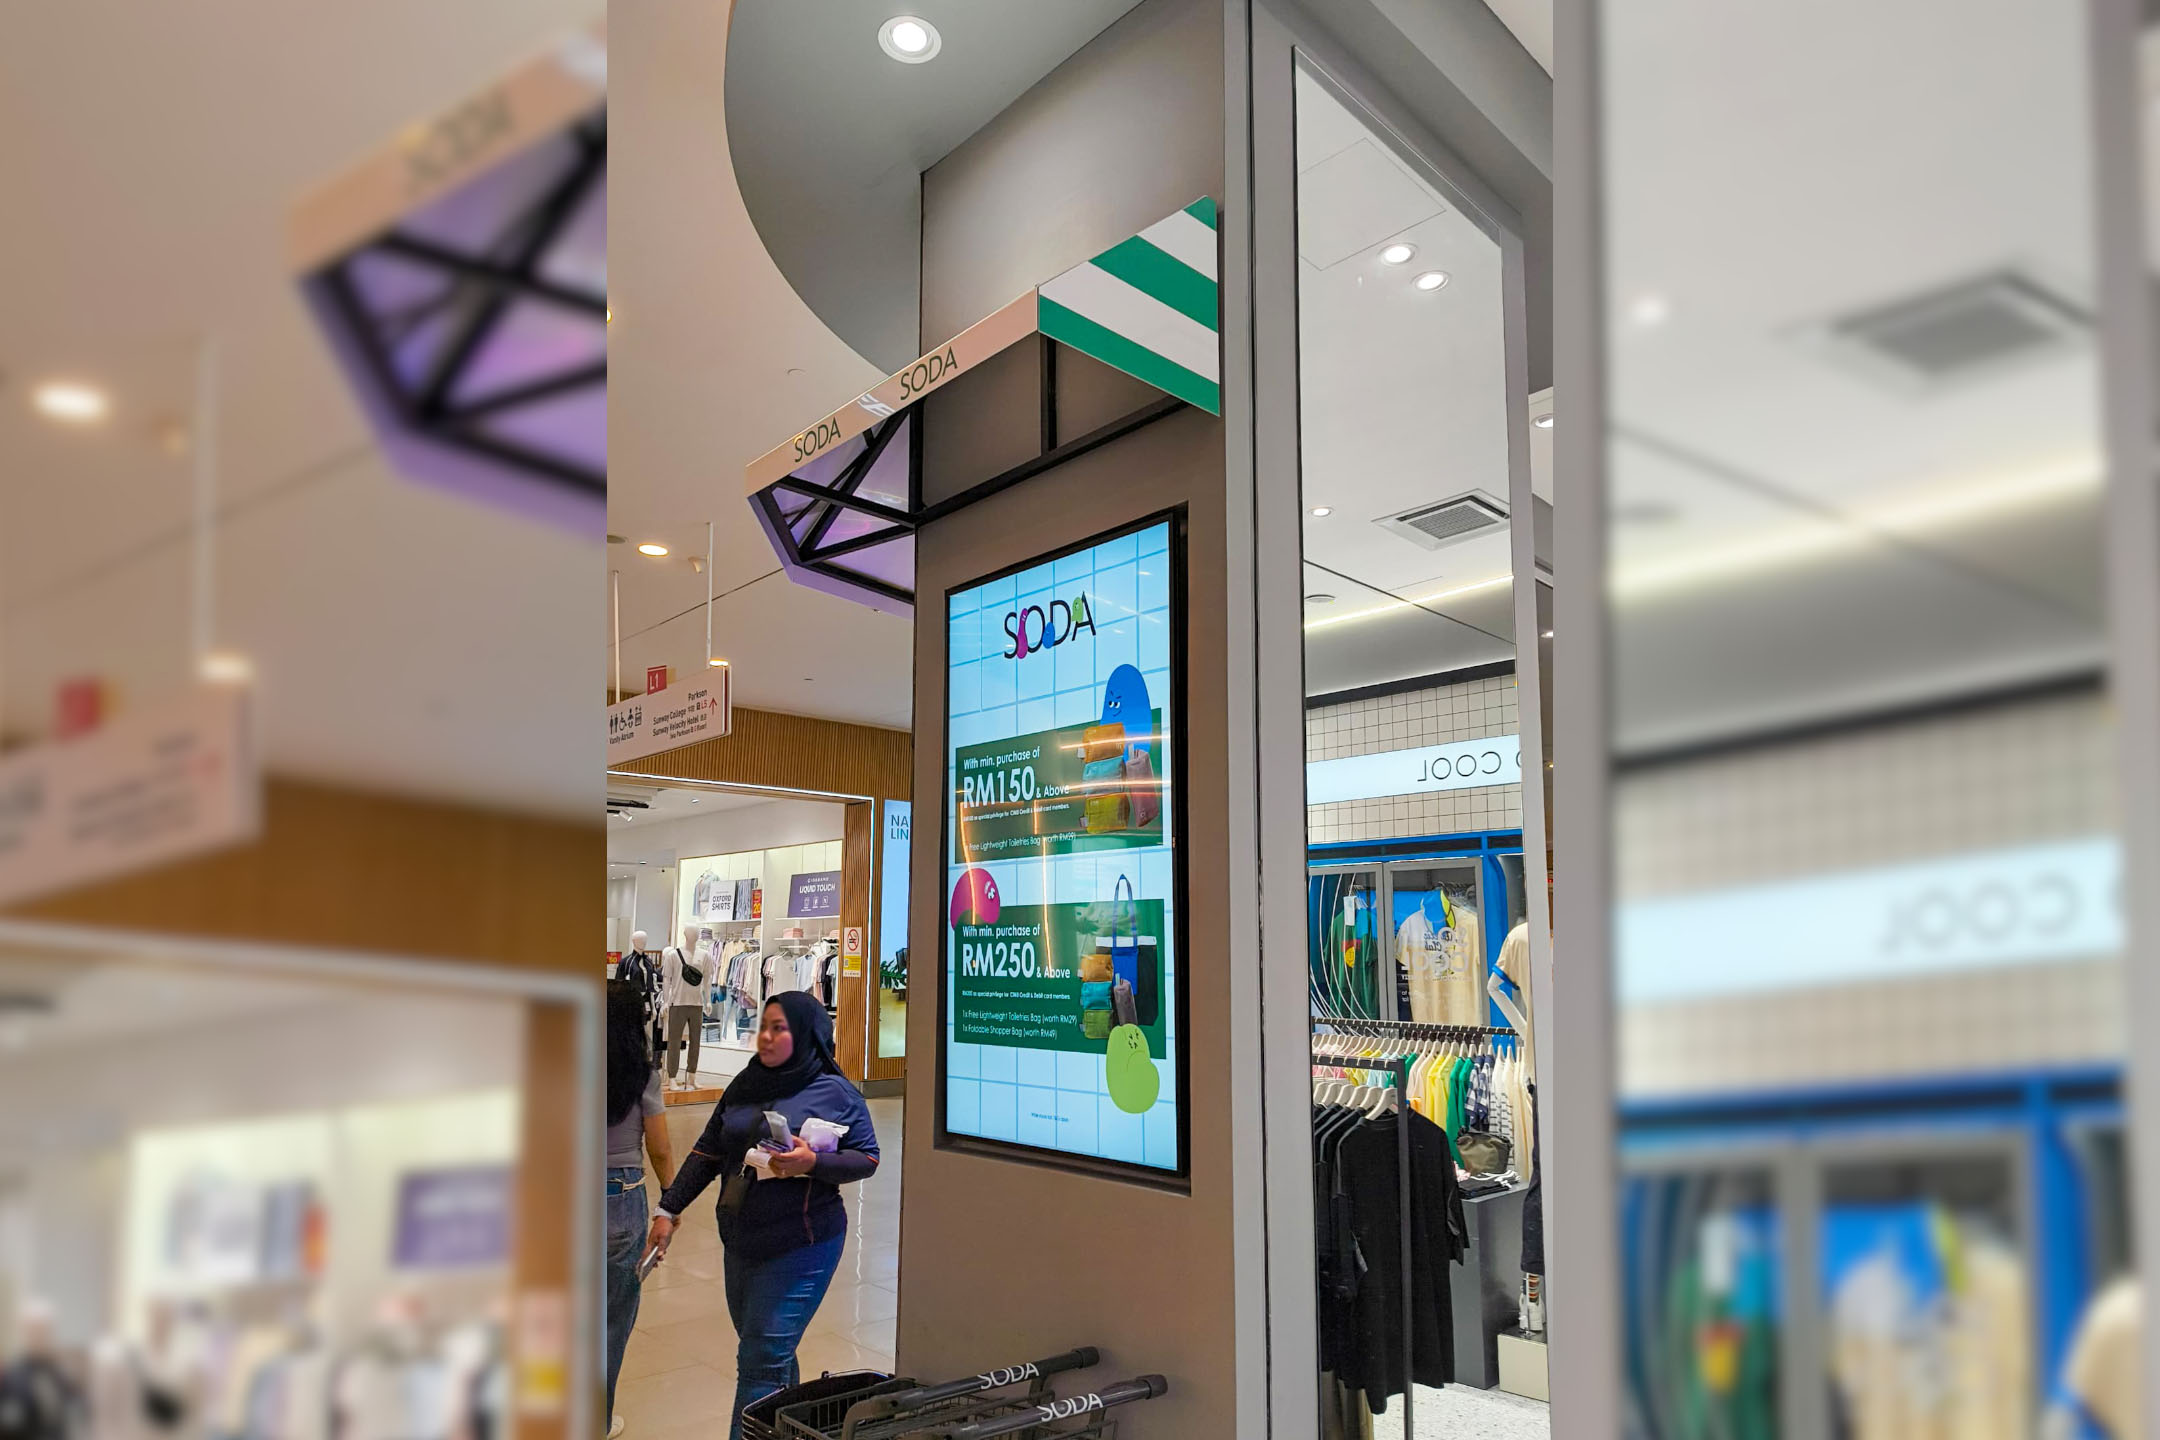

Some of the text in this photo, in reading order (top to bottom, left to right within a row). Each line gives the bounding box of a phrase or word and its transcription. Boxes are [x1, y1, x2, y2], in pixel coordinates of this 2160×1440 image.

[900, 345, 958, 401] SODA
[794, 416, 841, 463] SODA
[1003, 591, 1096, 659] SODA
[649, 673, 660, 690] L1
[688, 689, 708, 701] Parkson
[963, 746, 1040, 770] With min. purchase of
[963, 765, 1035, 809] RM150
[1035, 787, 1041, 799] &
[1043, 784, 1070, 797] Above
[1030, 836, 1041, 846] Bag
[799, 883, 836, 894] LIQUID TOUCH
[711, 902, 731, 911] SHIRTS
[962, 923, 1041, 939] With min. purchase of
[962, 941, 1071, 979] RM250 & Above
[979, 1010, 1008, 1022] Lightweight
[1030, 1012, 1041, 1025] Bag
[989, 1025, 1011, 1037] Shopper
[1011, 1026, 1022, 1038] Bag
[977, 1362, 1040, 1390] SODA
[1037, 1392, 1103, 1422] SODA
